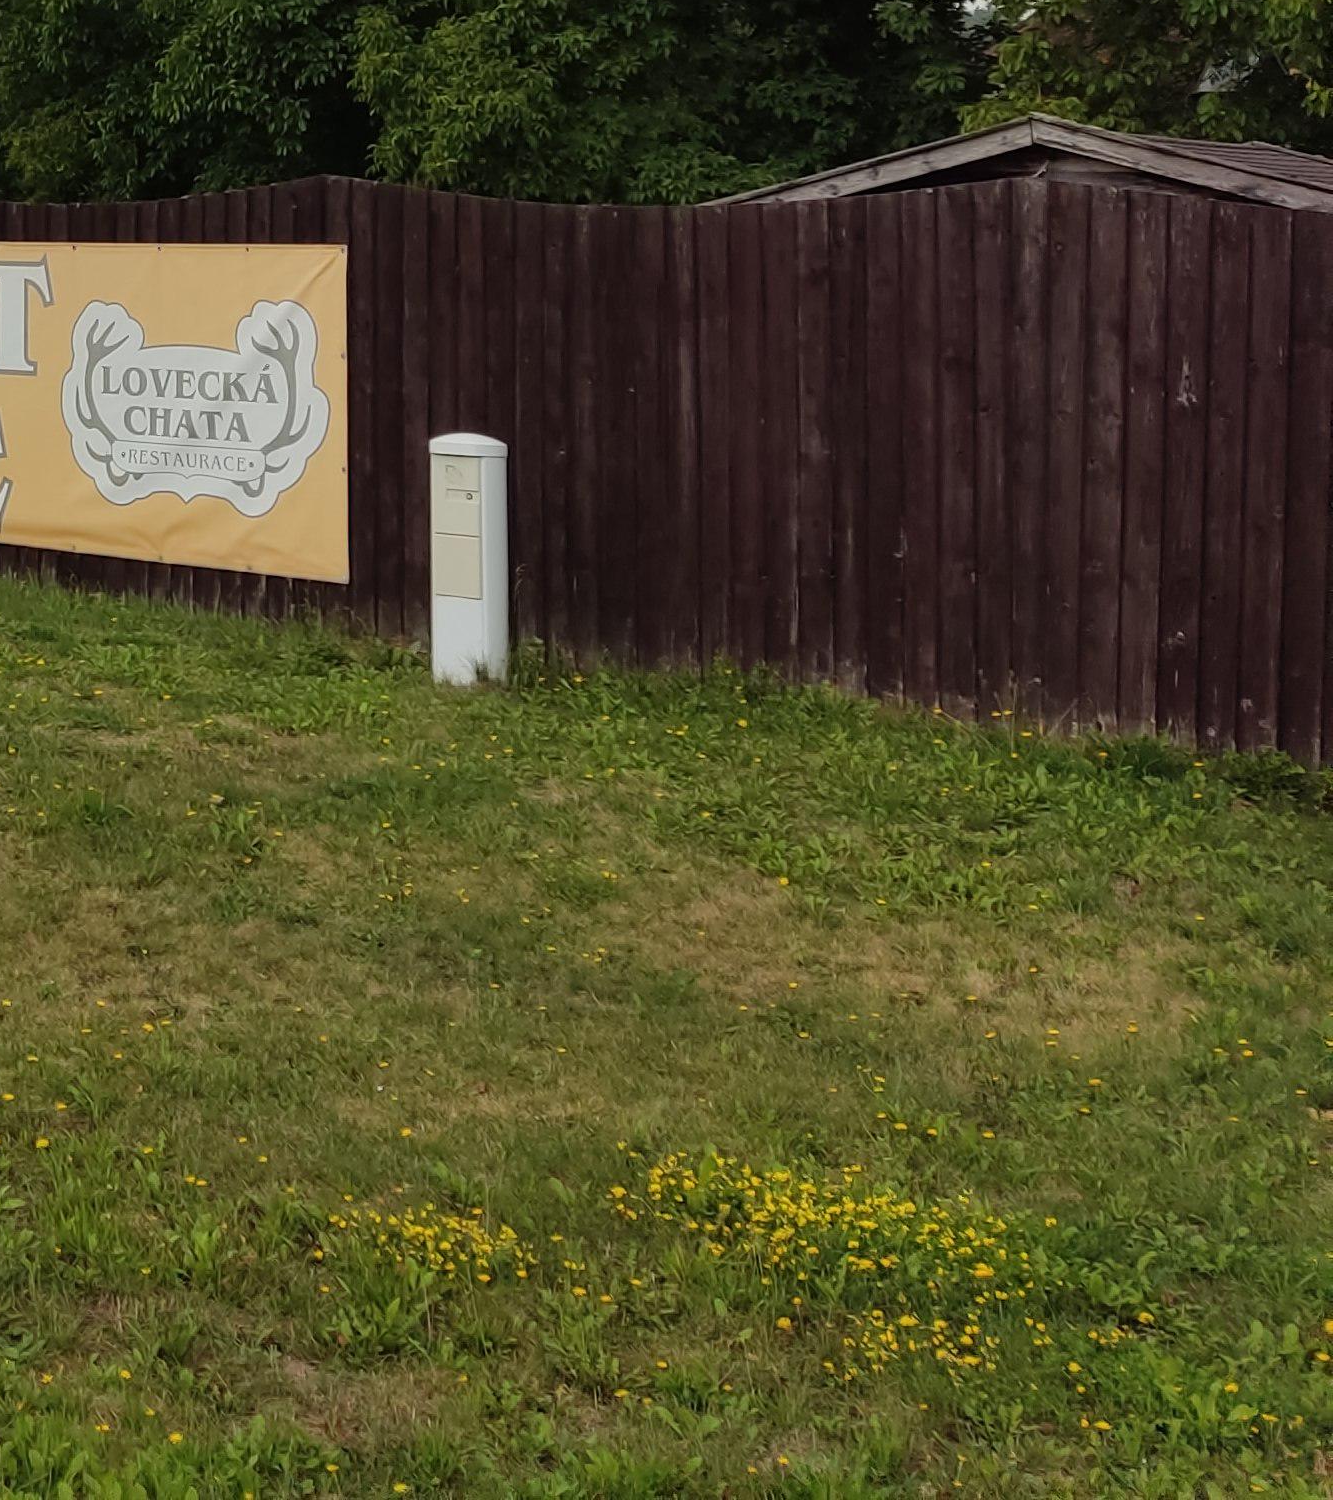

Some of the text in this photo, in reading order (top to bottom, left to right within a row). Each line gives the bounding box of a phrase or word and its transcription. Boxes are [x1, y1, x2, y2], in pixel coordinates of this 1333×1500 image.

[101, 363, 279, 404] LOVECKÁ
[123, 405, 252, 442] CHATA
[128, 448, 247, 472] RESTAURACE
